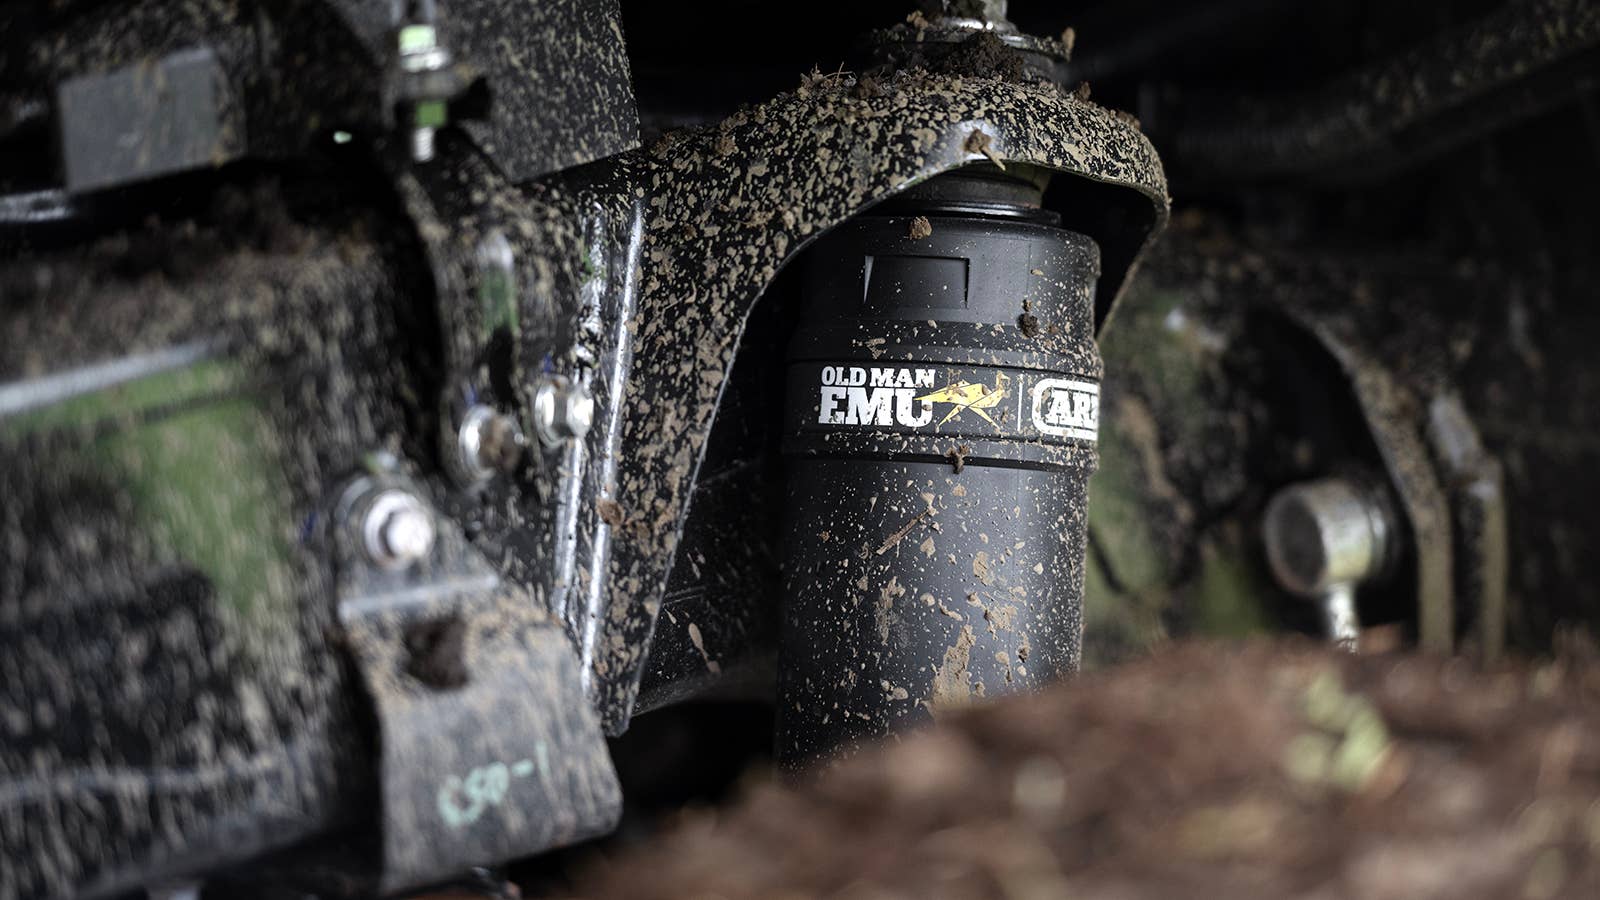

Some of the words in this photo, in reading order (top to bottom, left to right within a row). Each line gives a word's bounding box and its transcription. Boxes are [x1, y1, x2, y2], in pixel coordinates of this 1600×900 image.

[821, 366, 867, 386] OLD
[869, 367, 936, 388] MAN
[818, 386, 933, 427] EMU
